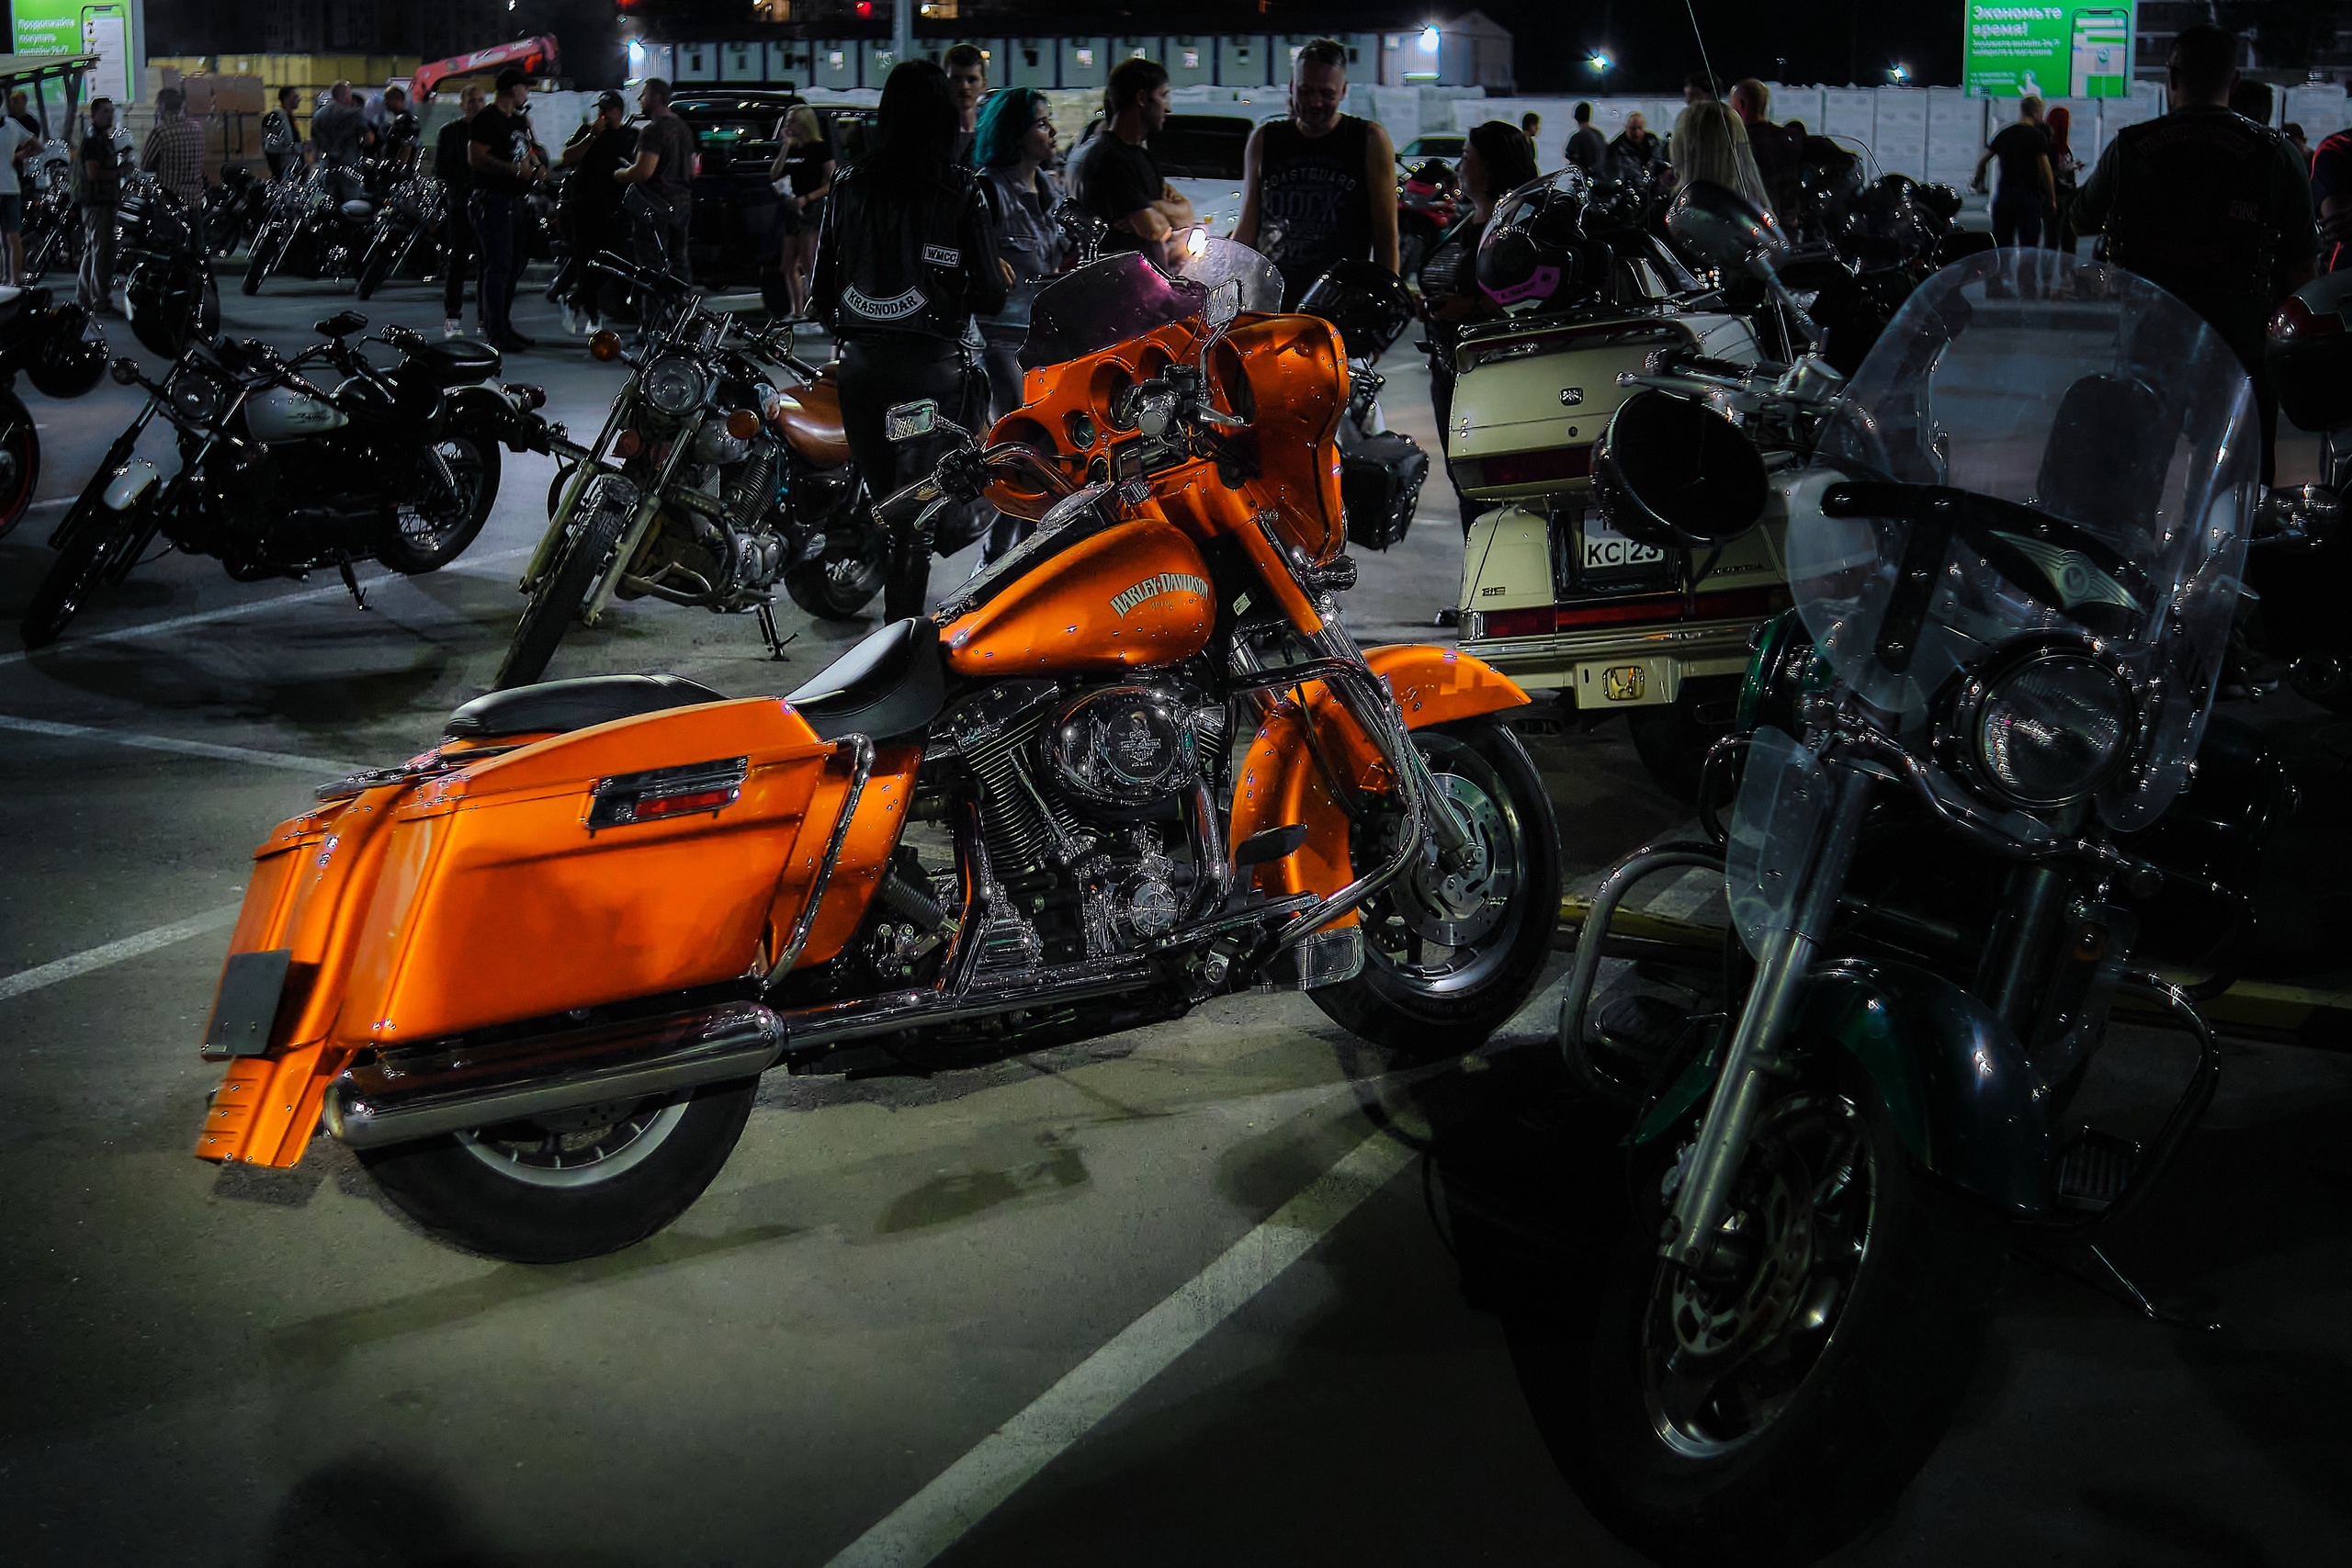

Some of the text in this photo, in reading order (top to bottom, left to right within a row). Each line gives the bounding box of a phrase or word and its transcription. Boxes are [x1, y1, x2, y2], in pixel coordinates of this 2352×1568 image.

[1973, 6, 2063, 19] Экономьте
[1973, 21, 2028, 39] время!
[927, 248, 957, 263] WMCC
[848, 291, 917, 316] KRASNODAR
[1588, 543, 1621, 566] KC
